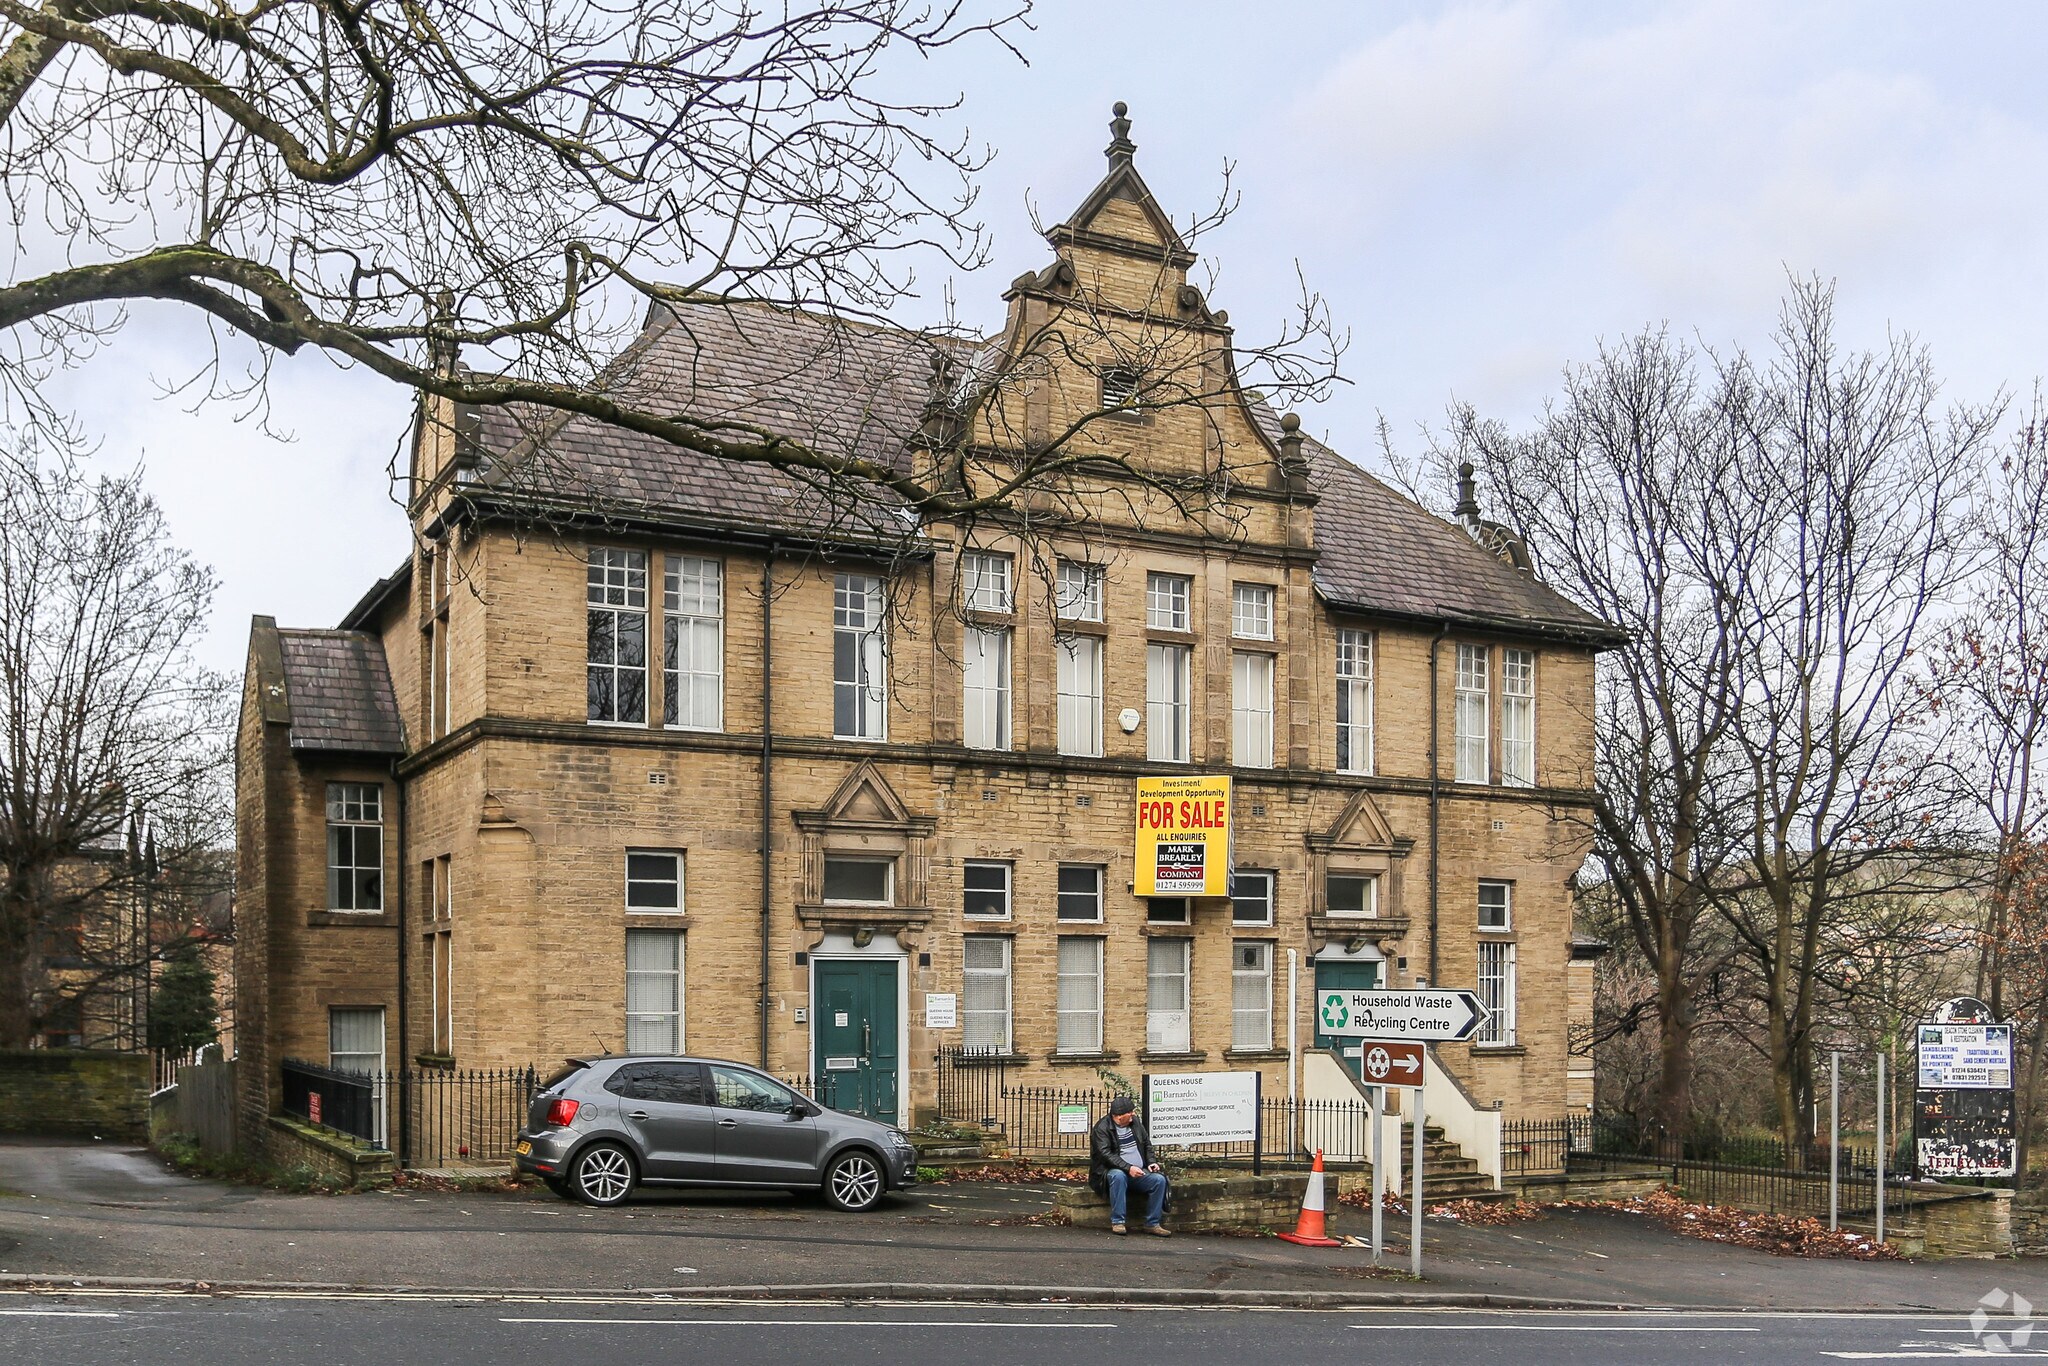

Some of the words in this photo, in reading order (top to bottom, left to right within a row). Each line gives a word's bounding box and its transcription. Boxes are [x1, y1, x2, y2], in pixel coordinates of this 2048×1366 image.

[1140, 789, 1184, 799] Development
[1185, 788, 1225, 798] Opportunity
[1139, 802, 1174, 829] FOR
[1180, 801, 1225, 828] SALE
[1170, 833, 1207, 841] ENQUIRIES
[1158, 854, 1203, 862] BREARLEY
[1178, 881, 1204, 889] 595999
[1352, 995, 1411, 1008] Household
[1414, 996, 1453, 1009] Waste
[1354, 1016, 1406, 1031] Recycling
[1409, 1018, 1450, 1030] Centre
[1163, 1090, 1198, 1098] Barnardo's
